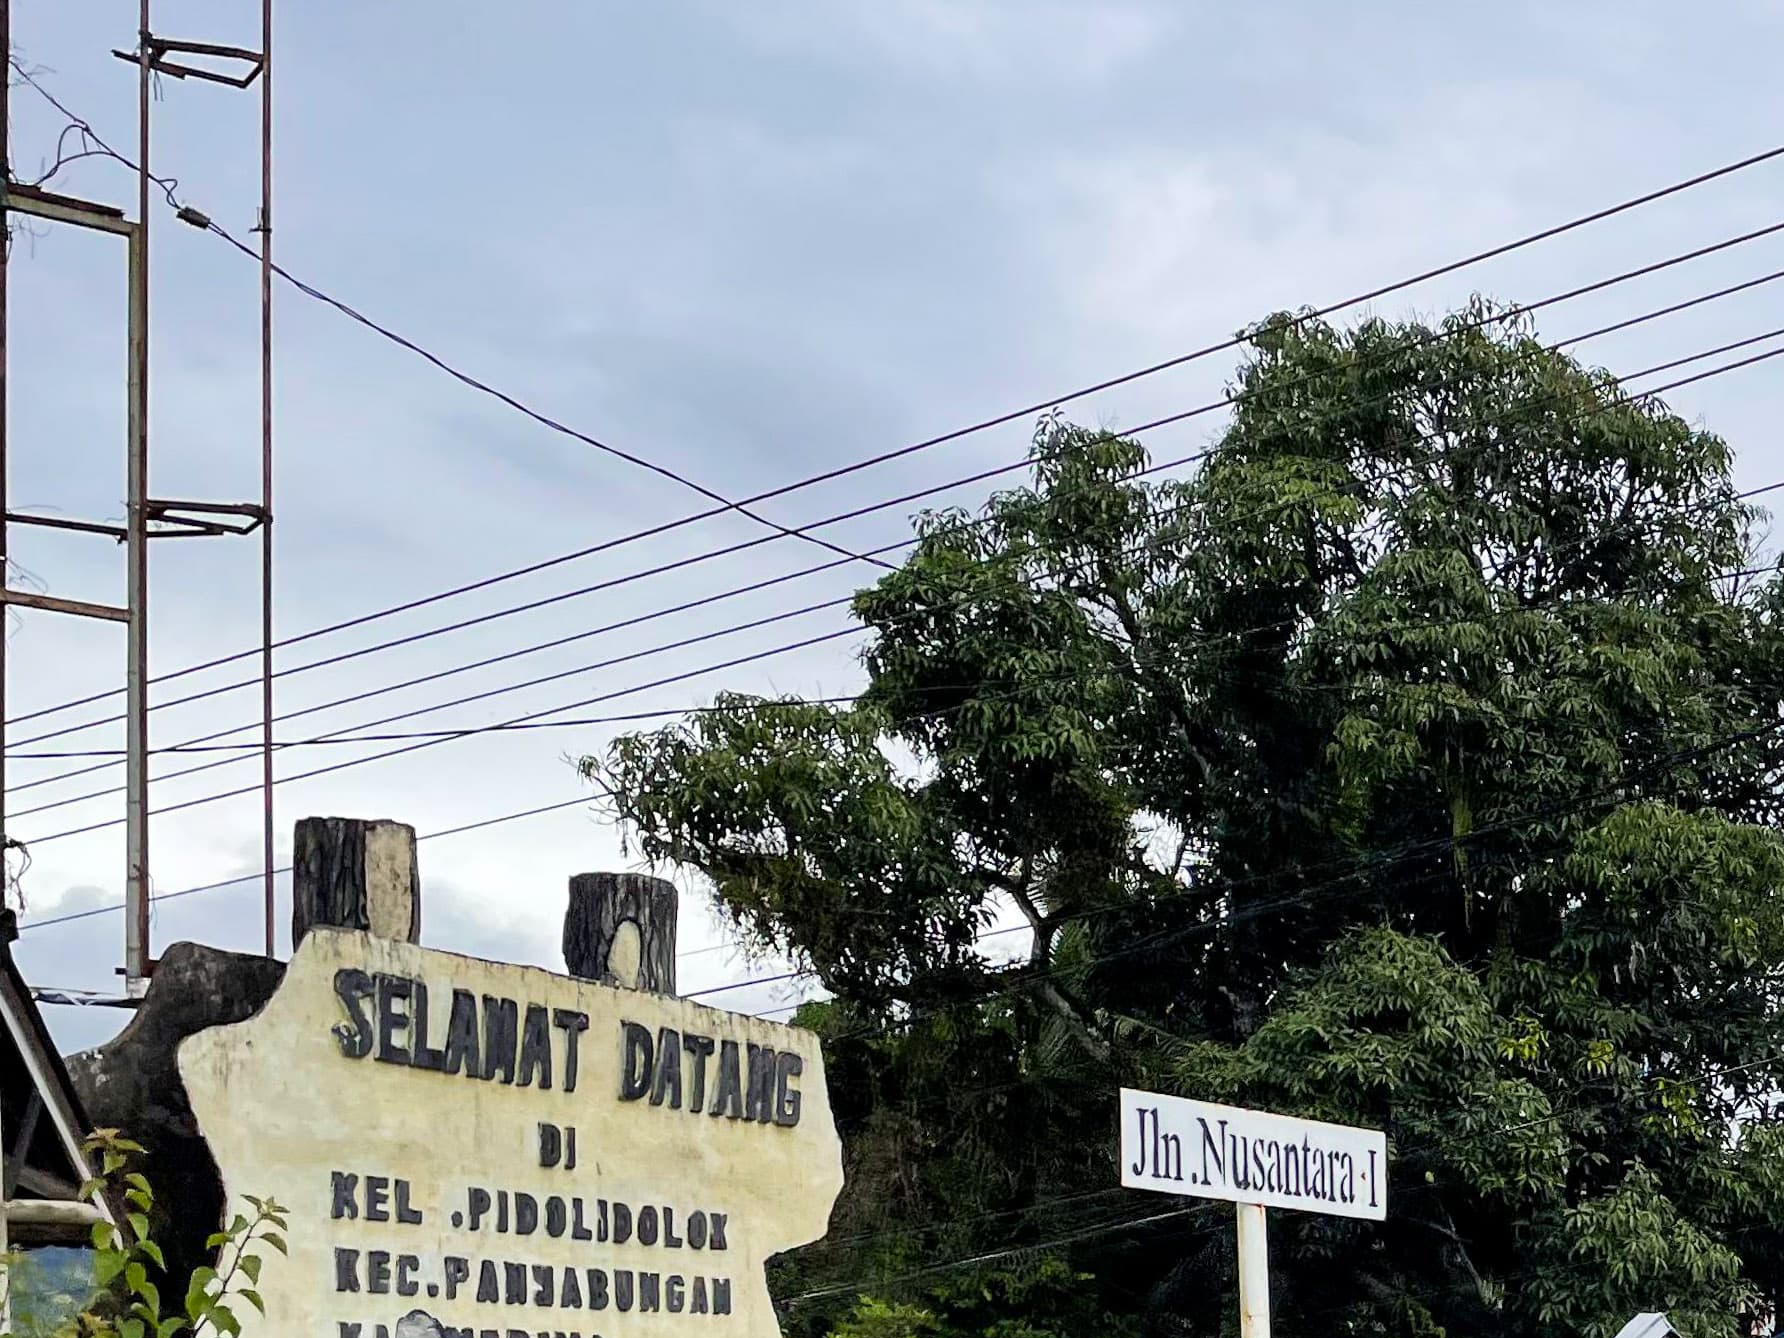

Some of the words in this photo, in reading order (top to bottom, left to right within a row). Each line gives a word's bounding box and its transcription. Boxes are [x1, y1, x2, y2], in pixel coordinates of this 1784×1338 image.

[332, 968, 590, 1092] SELAMAT
[618, 1018, 803, 1127] DATANG
[538, 1122, 576, 1169] DI
